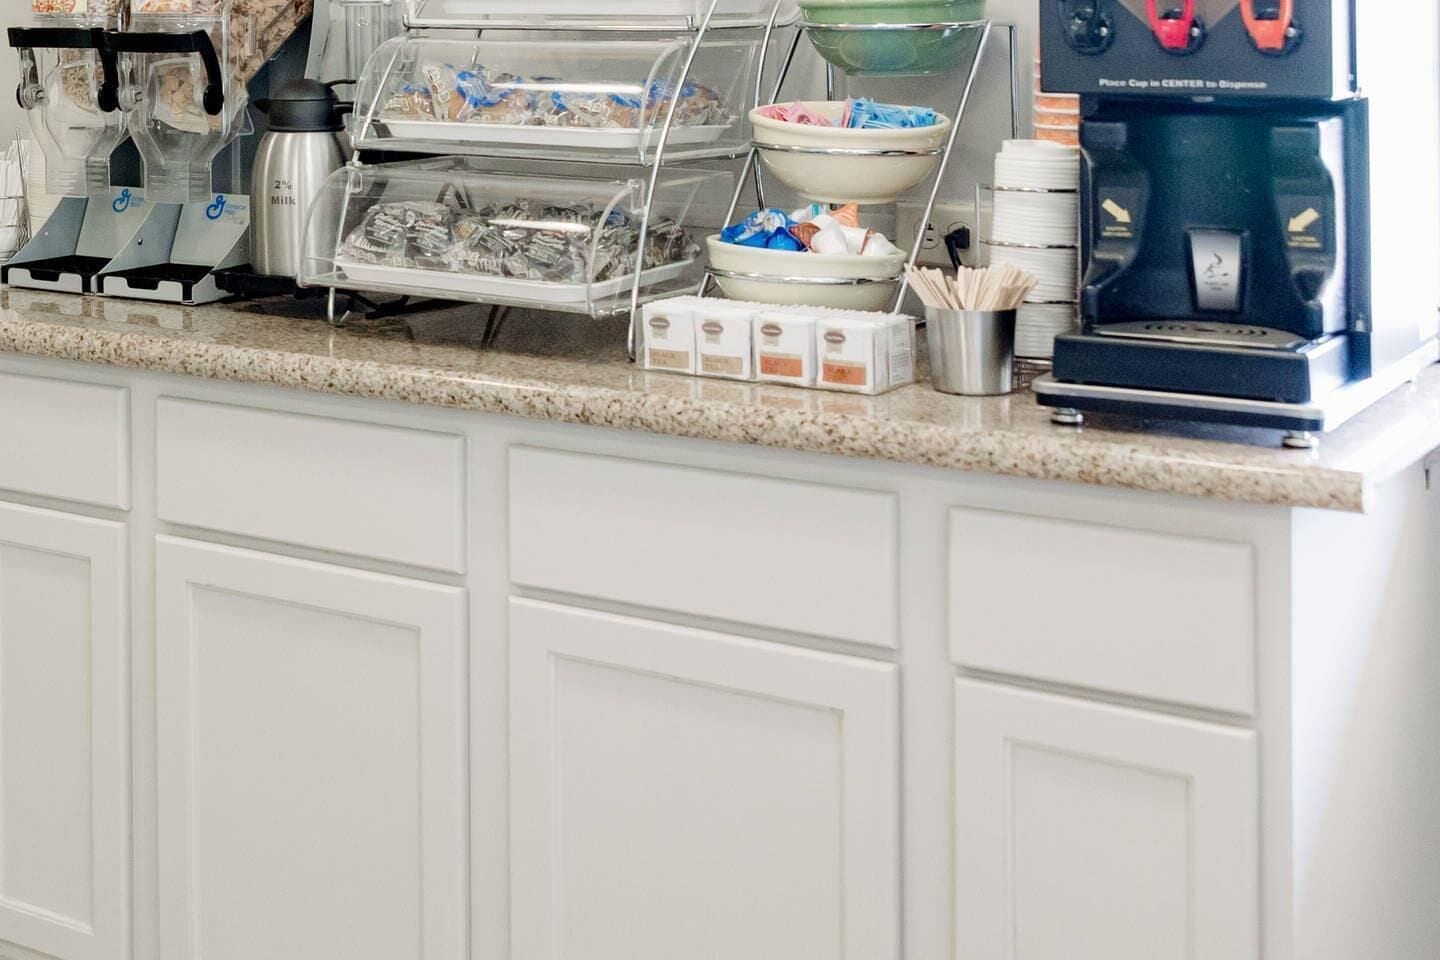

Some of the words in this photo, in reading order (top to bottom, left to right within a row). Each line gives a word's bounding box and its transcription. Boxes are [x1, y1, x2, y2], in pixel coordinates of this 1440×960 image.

[1098, 78, 1127, 87] Place
[1128, 78, 1148, 88] Cup
[1149, 78, 1161, 87] in
[1161, 79, 1204, 88] CENTER
[1206, 80, 1217, 88] to
[1218, 79, 1268, 90] Dispense
[274, 180, 292, 189] 2%
[271, 195, 296, 205] Milk
